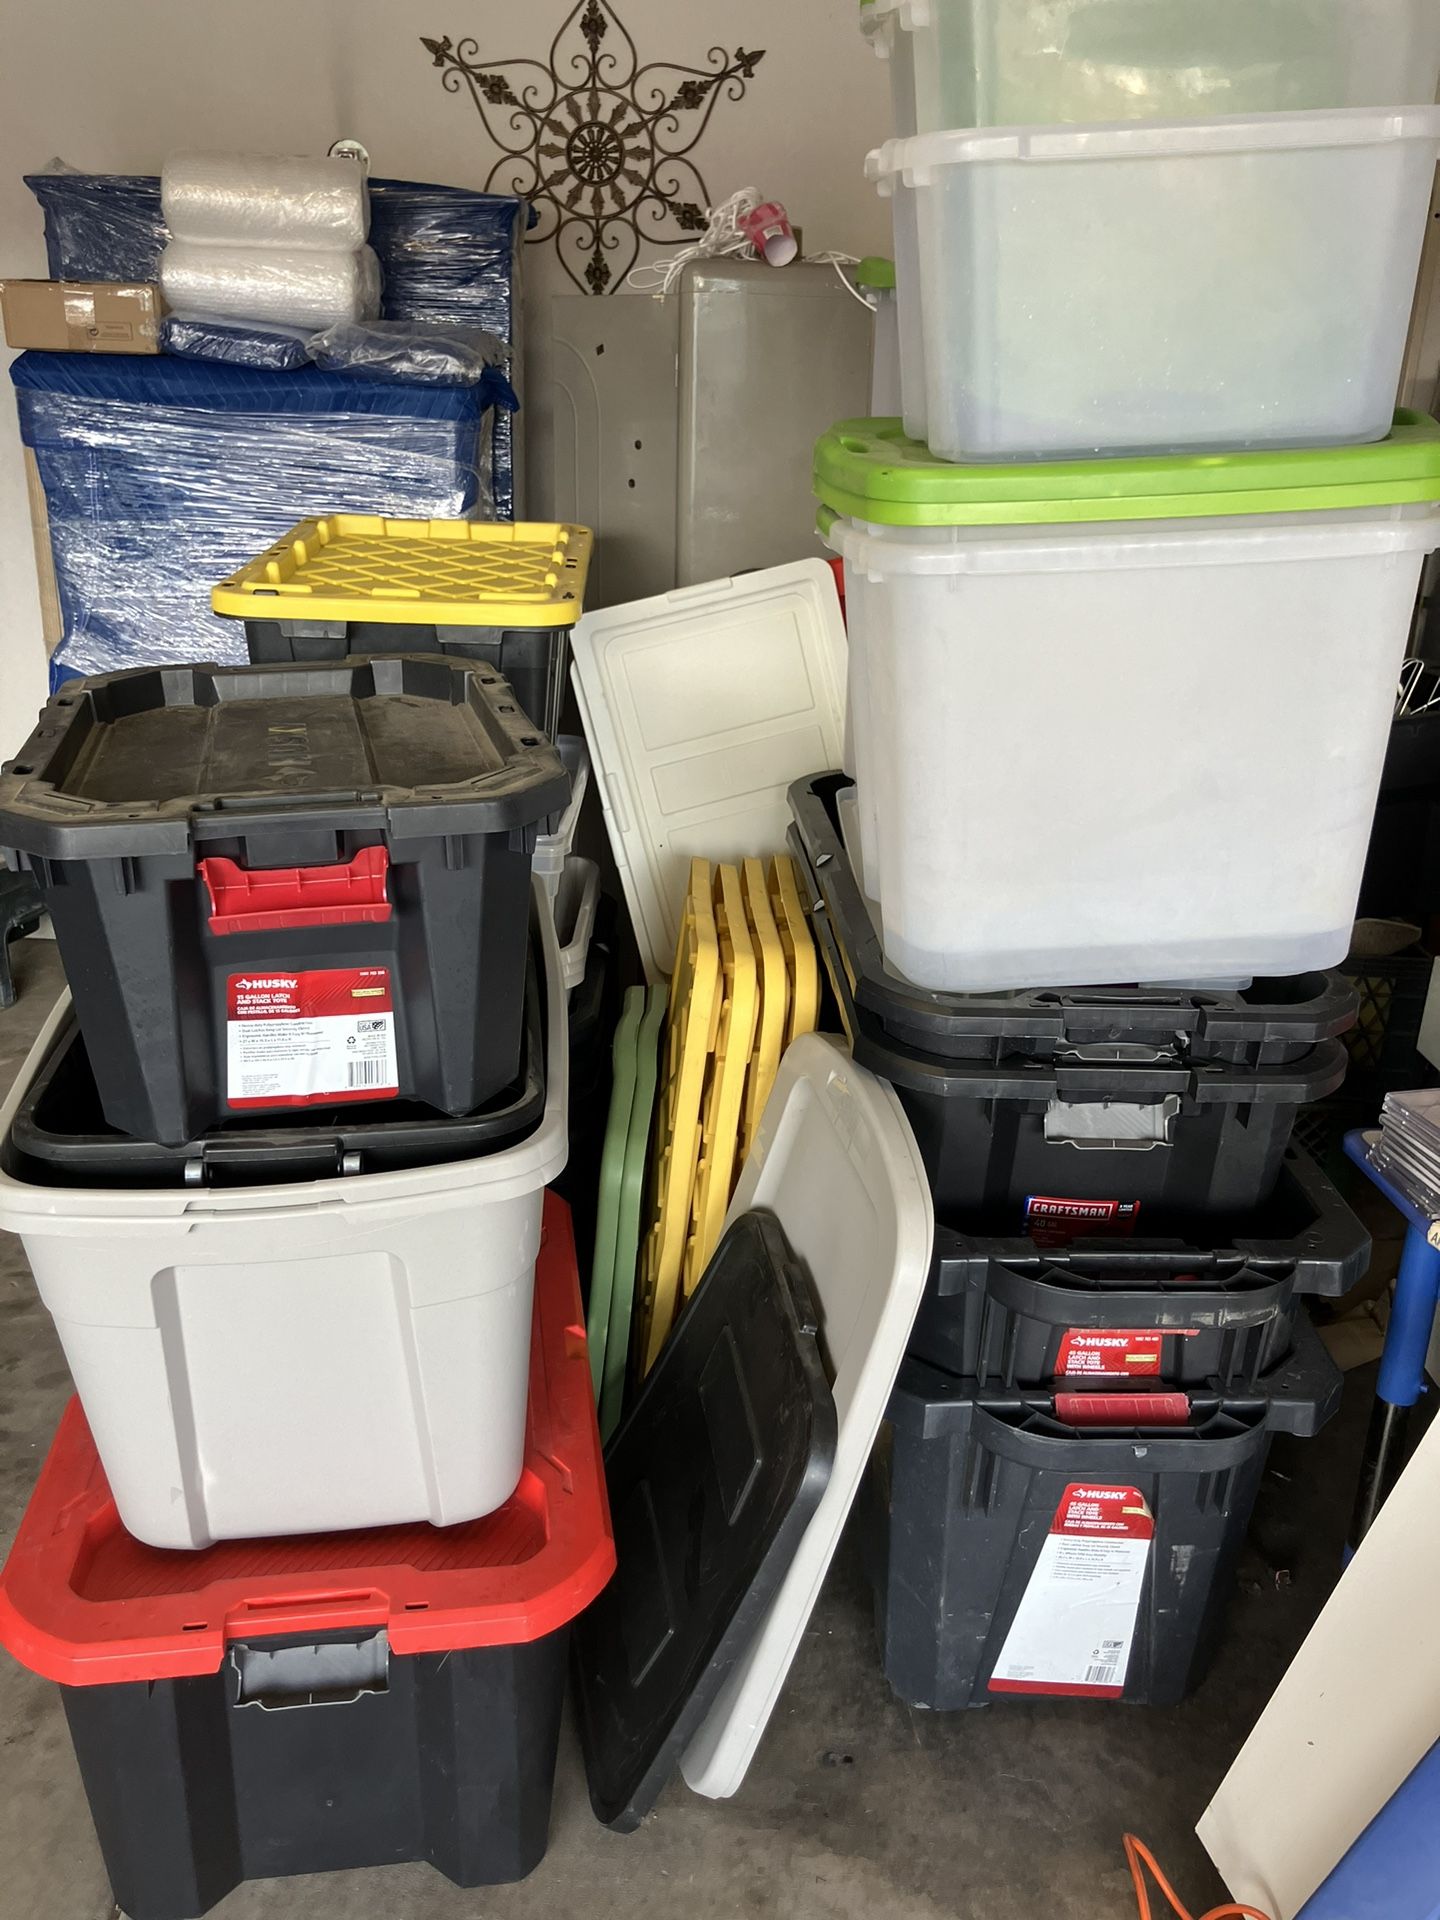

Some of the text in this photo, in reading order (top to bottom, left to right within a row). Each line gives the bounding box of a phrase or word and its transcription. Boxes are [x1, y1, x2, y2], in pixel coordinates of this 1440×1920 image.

[252, 979, 298, 989] HUSKY
[1033, 1203, 1107, 1217] CRAFTSMAN
[1085, 1338, 1128, 1347] HUSKY
[1086, 1490, 1127, 1500] HUSKY
